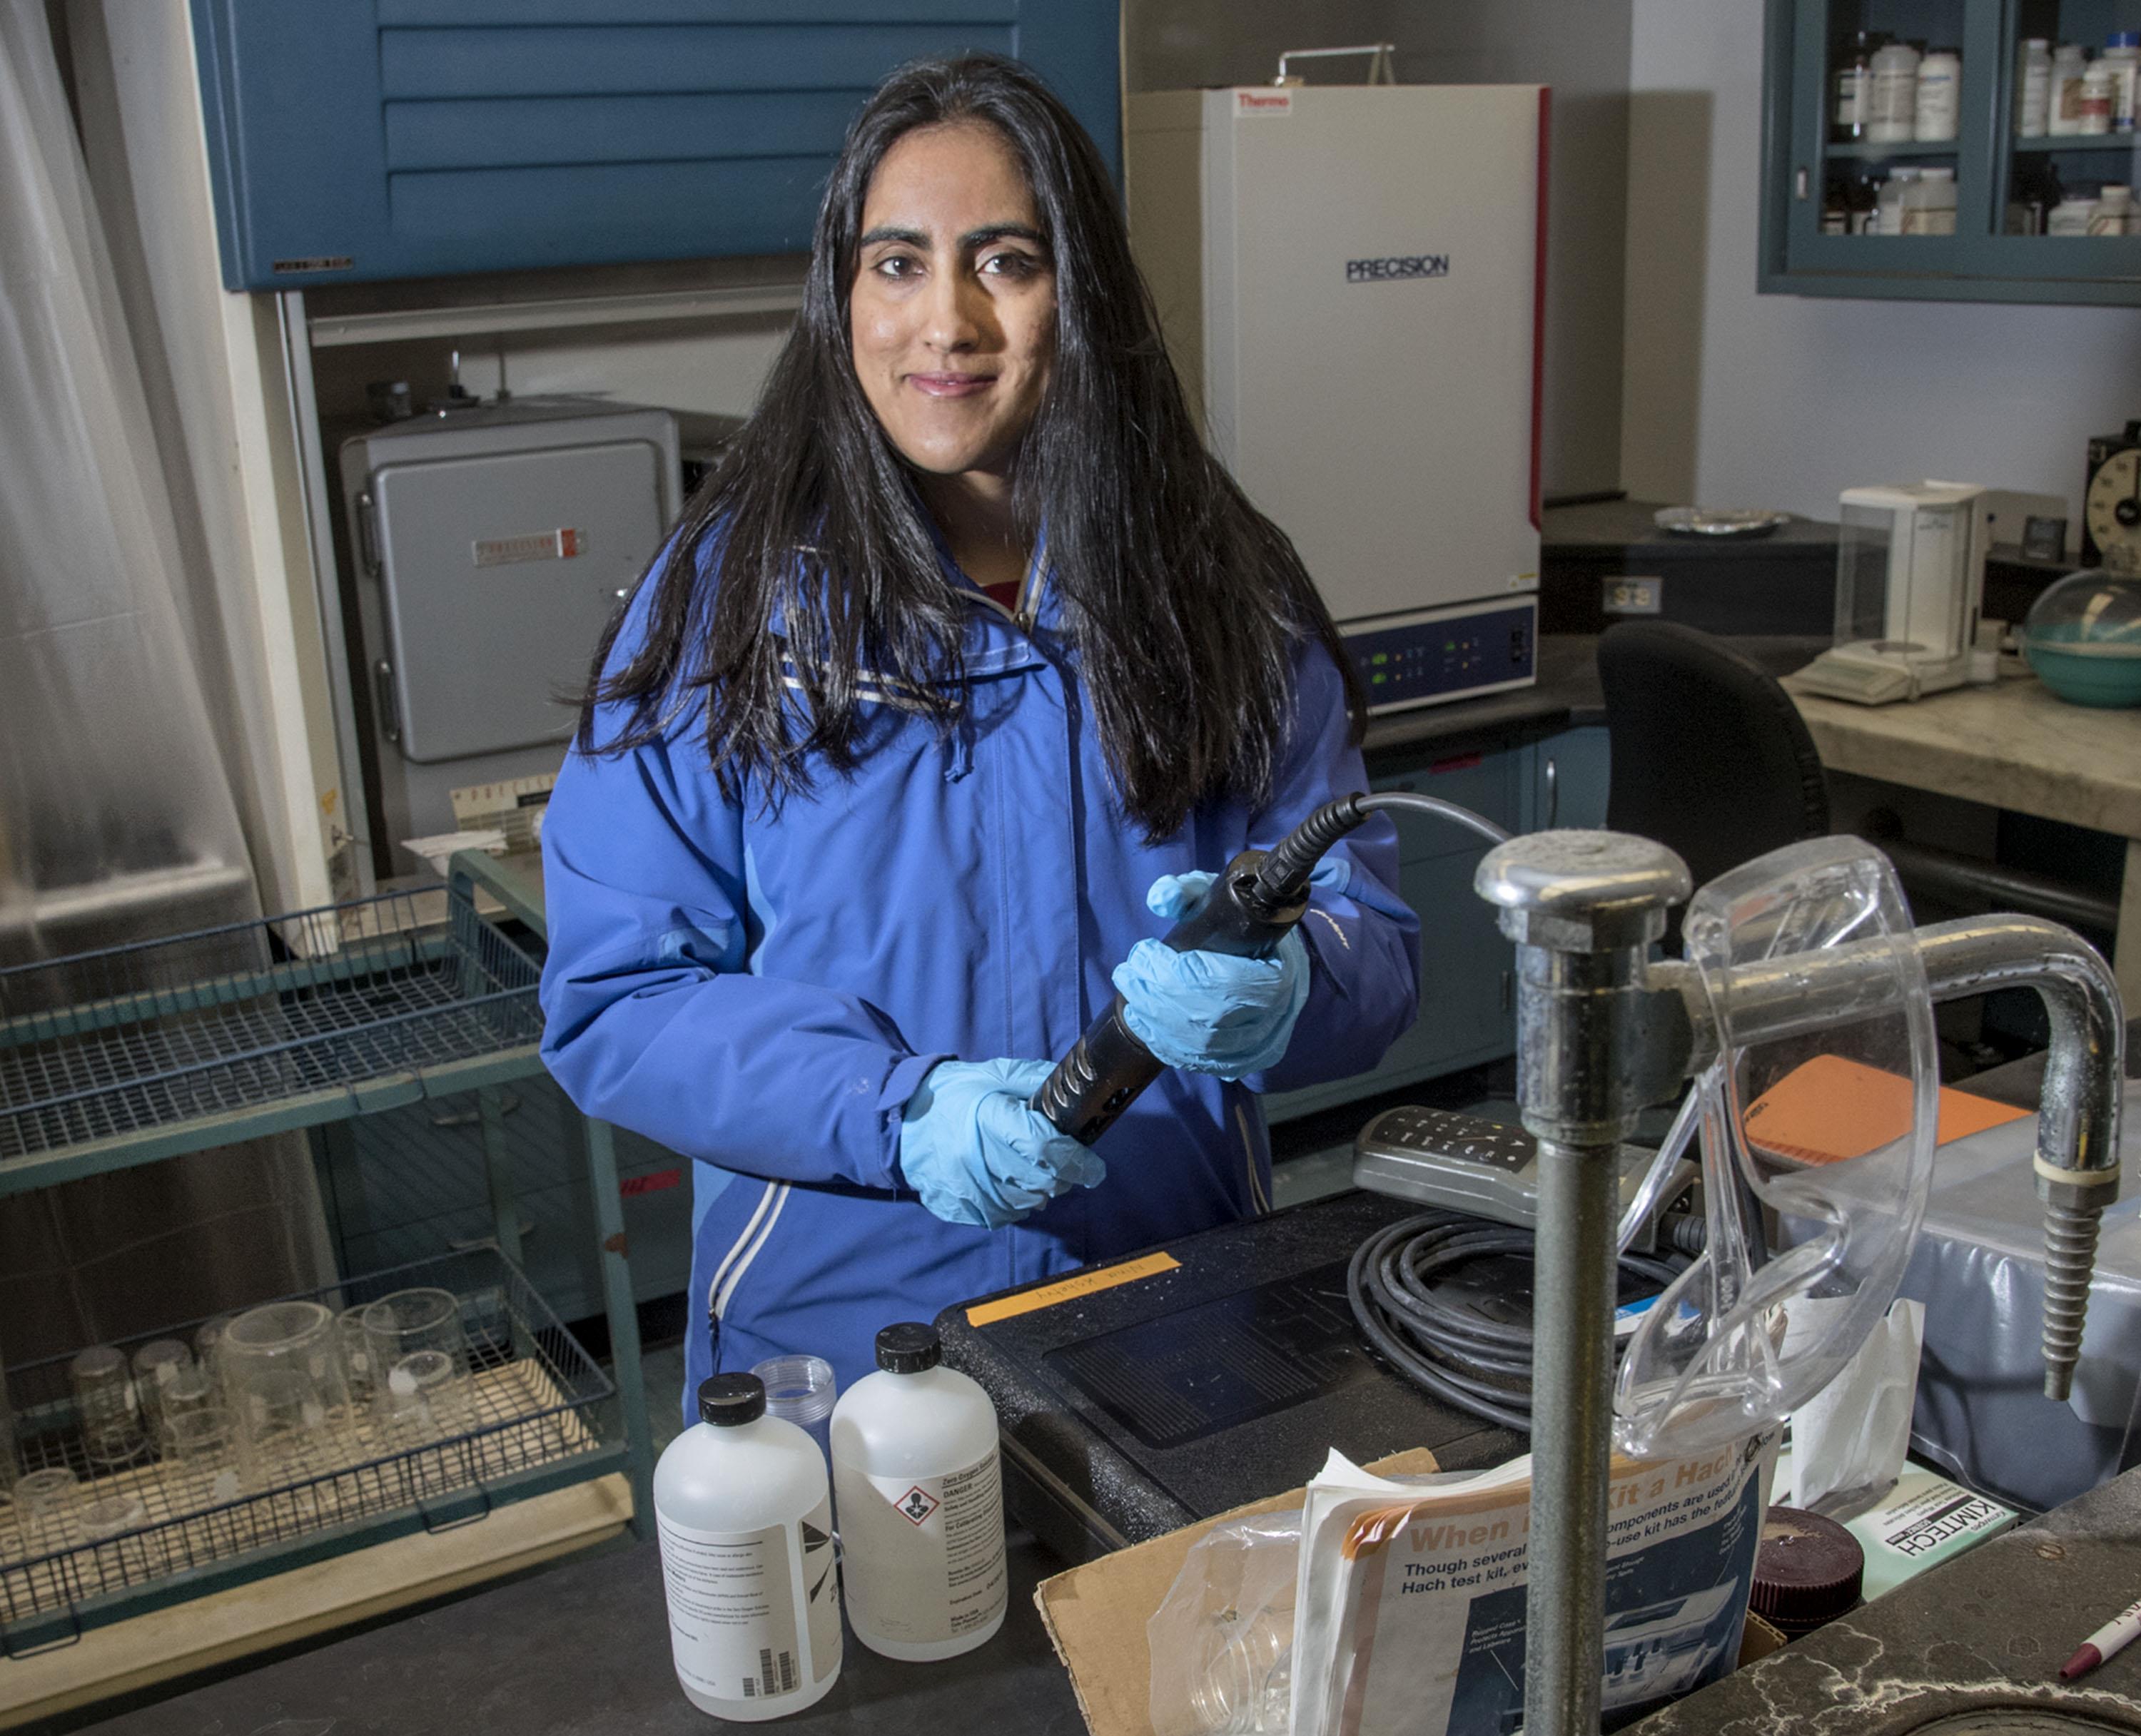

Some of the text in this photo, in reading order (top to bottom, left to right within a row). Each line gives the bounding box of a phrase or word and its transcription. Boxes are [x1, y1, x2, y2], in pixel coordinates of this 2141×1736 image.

[1347, 255, 1449, 281] PRECISION
[1402, 1579, 1445, 1594] Hach
[1451, 1573, 1482, 1588] test
[1486, 1566, 1507, 1582] kit,
[1644, 1521, 1661, 1538] kit
[1664, 1513, 1688, 1531] has
[1691, 1506, 1711, 1521] the
[1404, 1474, 1731, 1576] Though several omponents are used
[1410, 1521, 1509, 1552] When
[1645, 1478, 1665, 1498] a
[1897, 1500, 1996, 1557] KIMTECH
